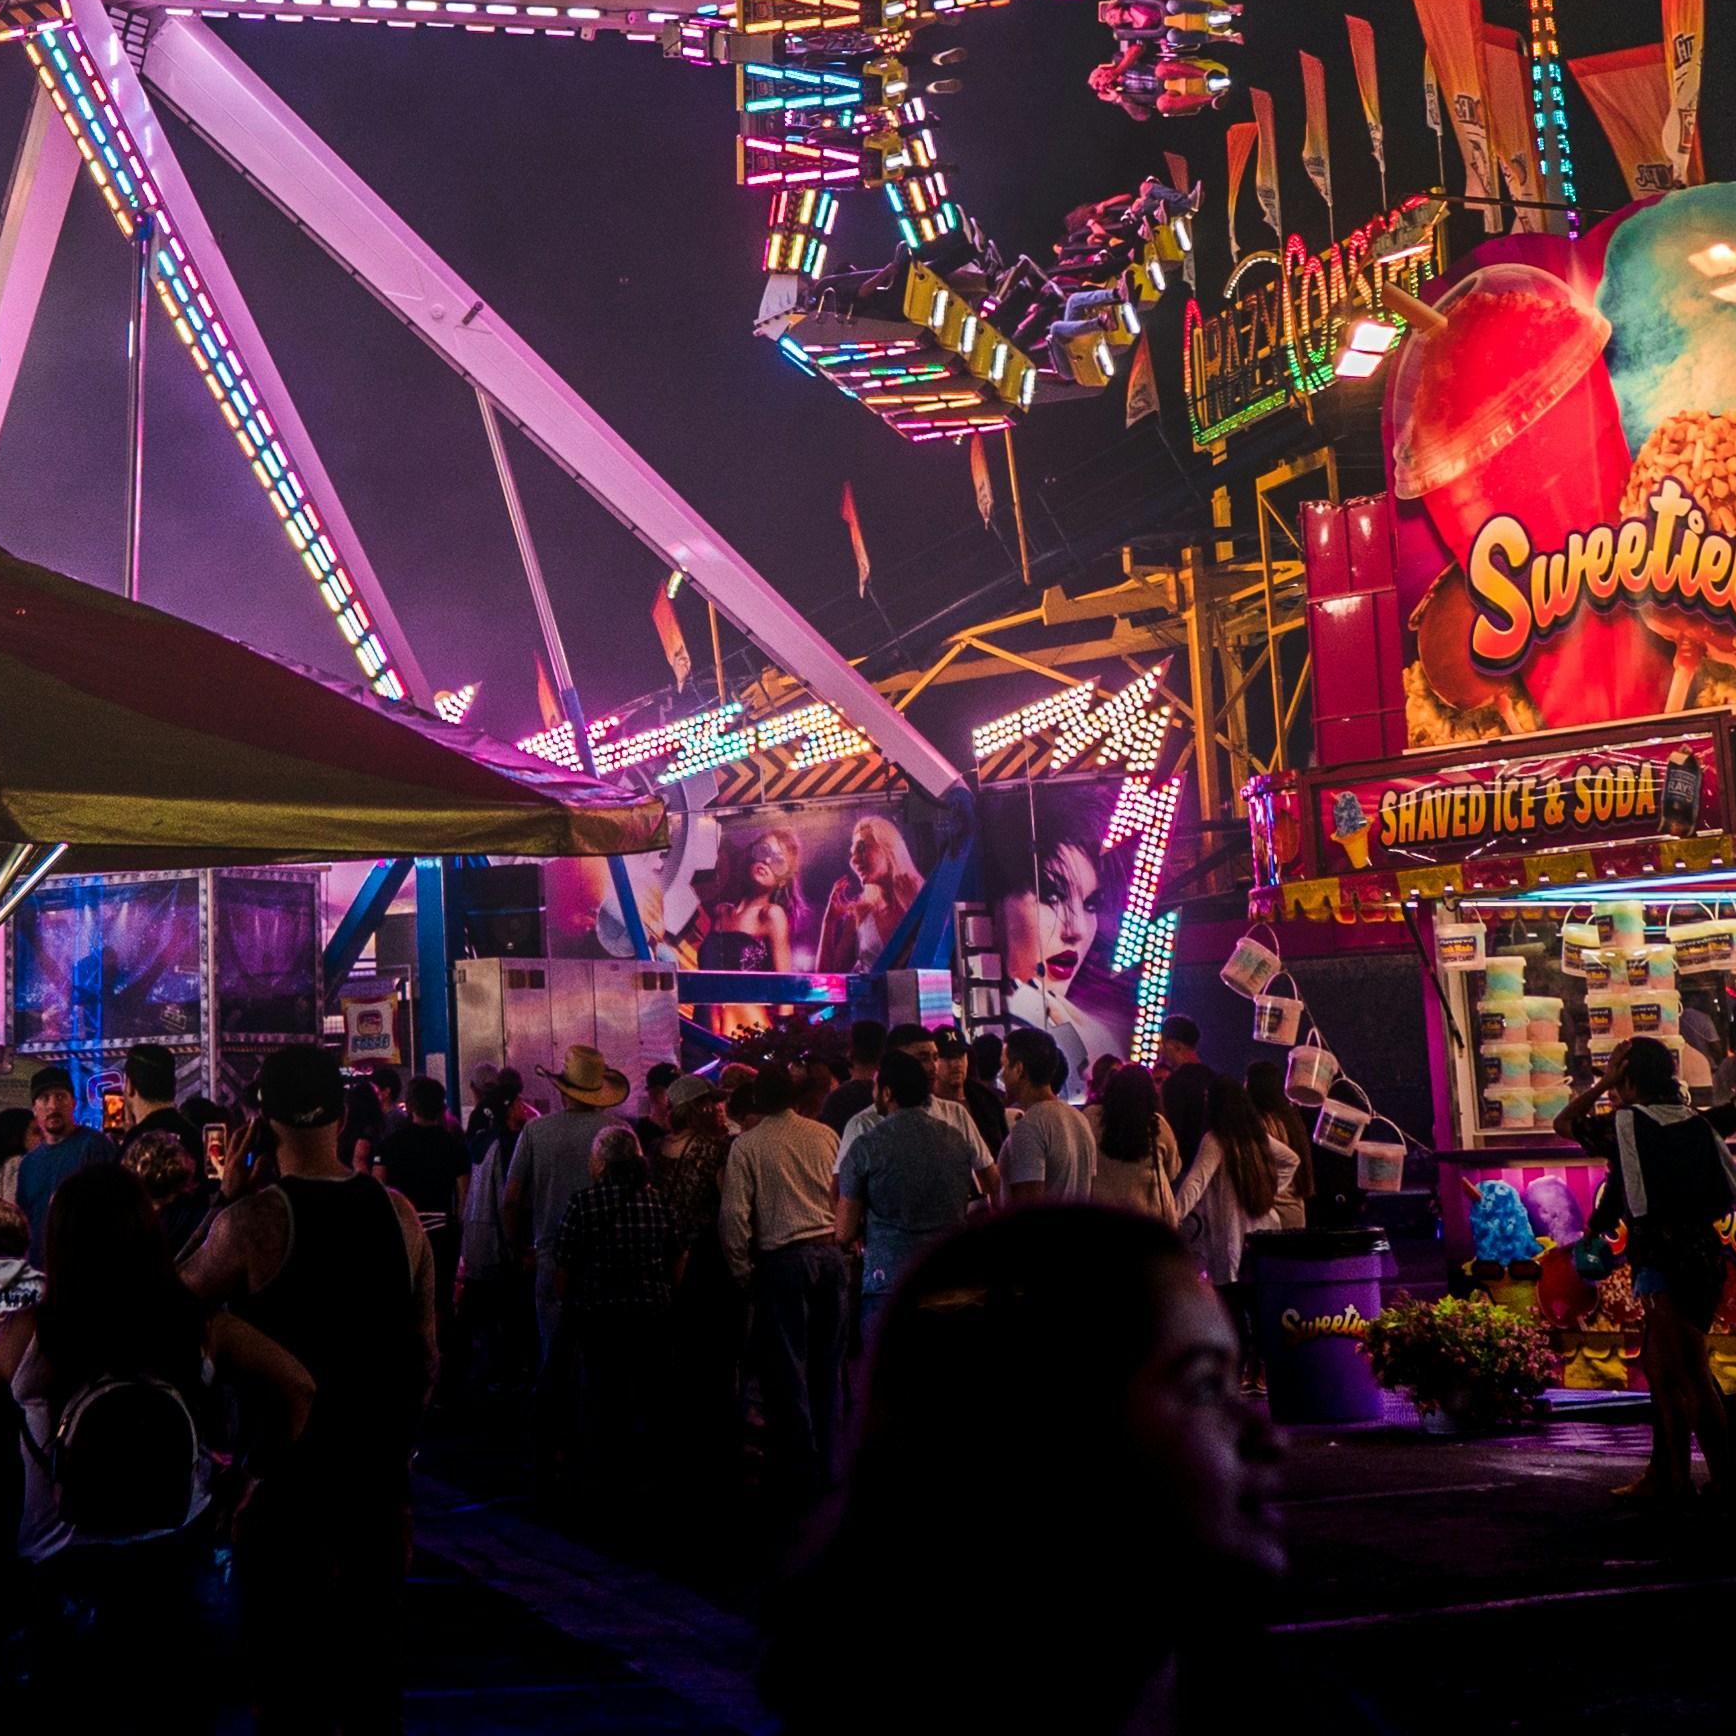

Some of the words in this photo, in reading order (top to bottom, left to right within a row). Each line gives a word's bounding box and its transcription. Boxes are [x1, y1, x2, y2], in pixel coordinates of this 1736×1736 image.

[1380, 787, 1486, 847] SHAVED
[1493, 775, 1536, 834] ICE
[1543, 779, 1566, 823] &
[1574, 762, 1657, 823] SODA
